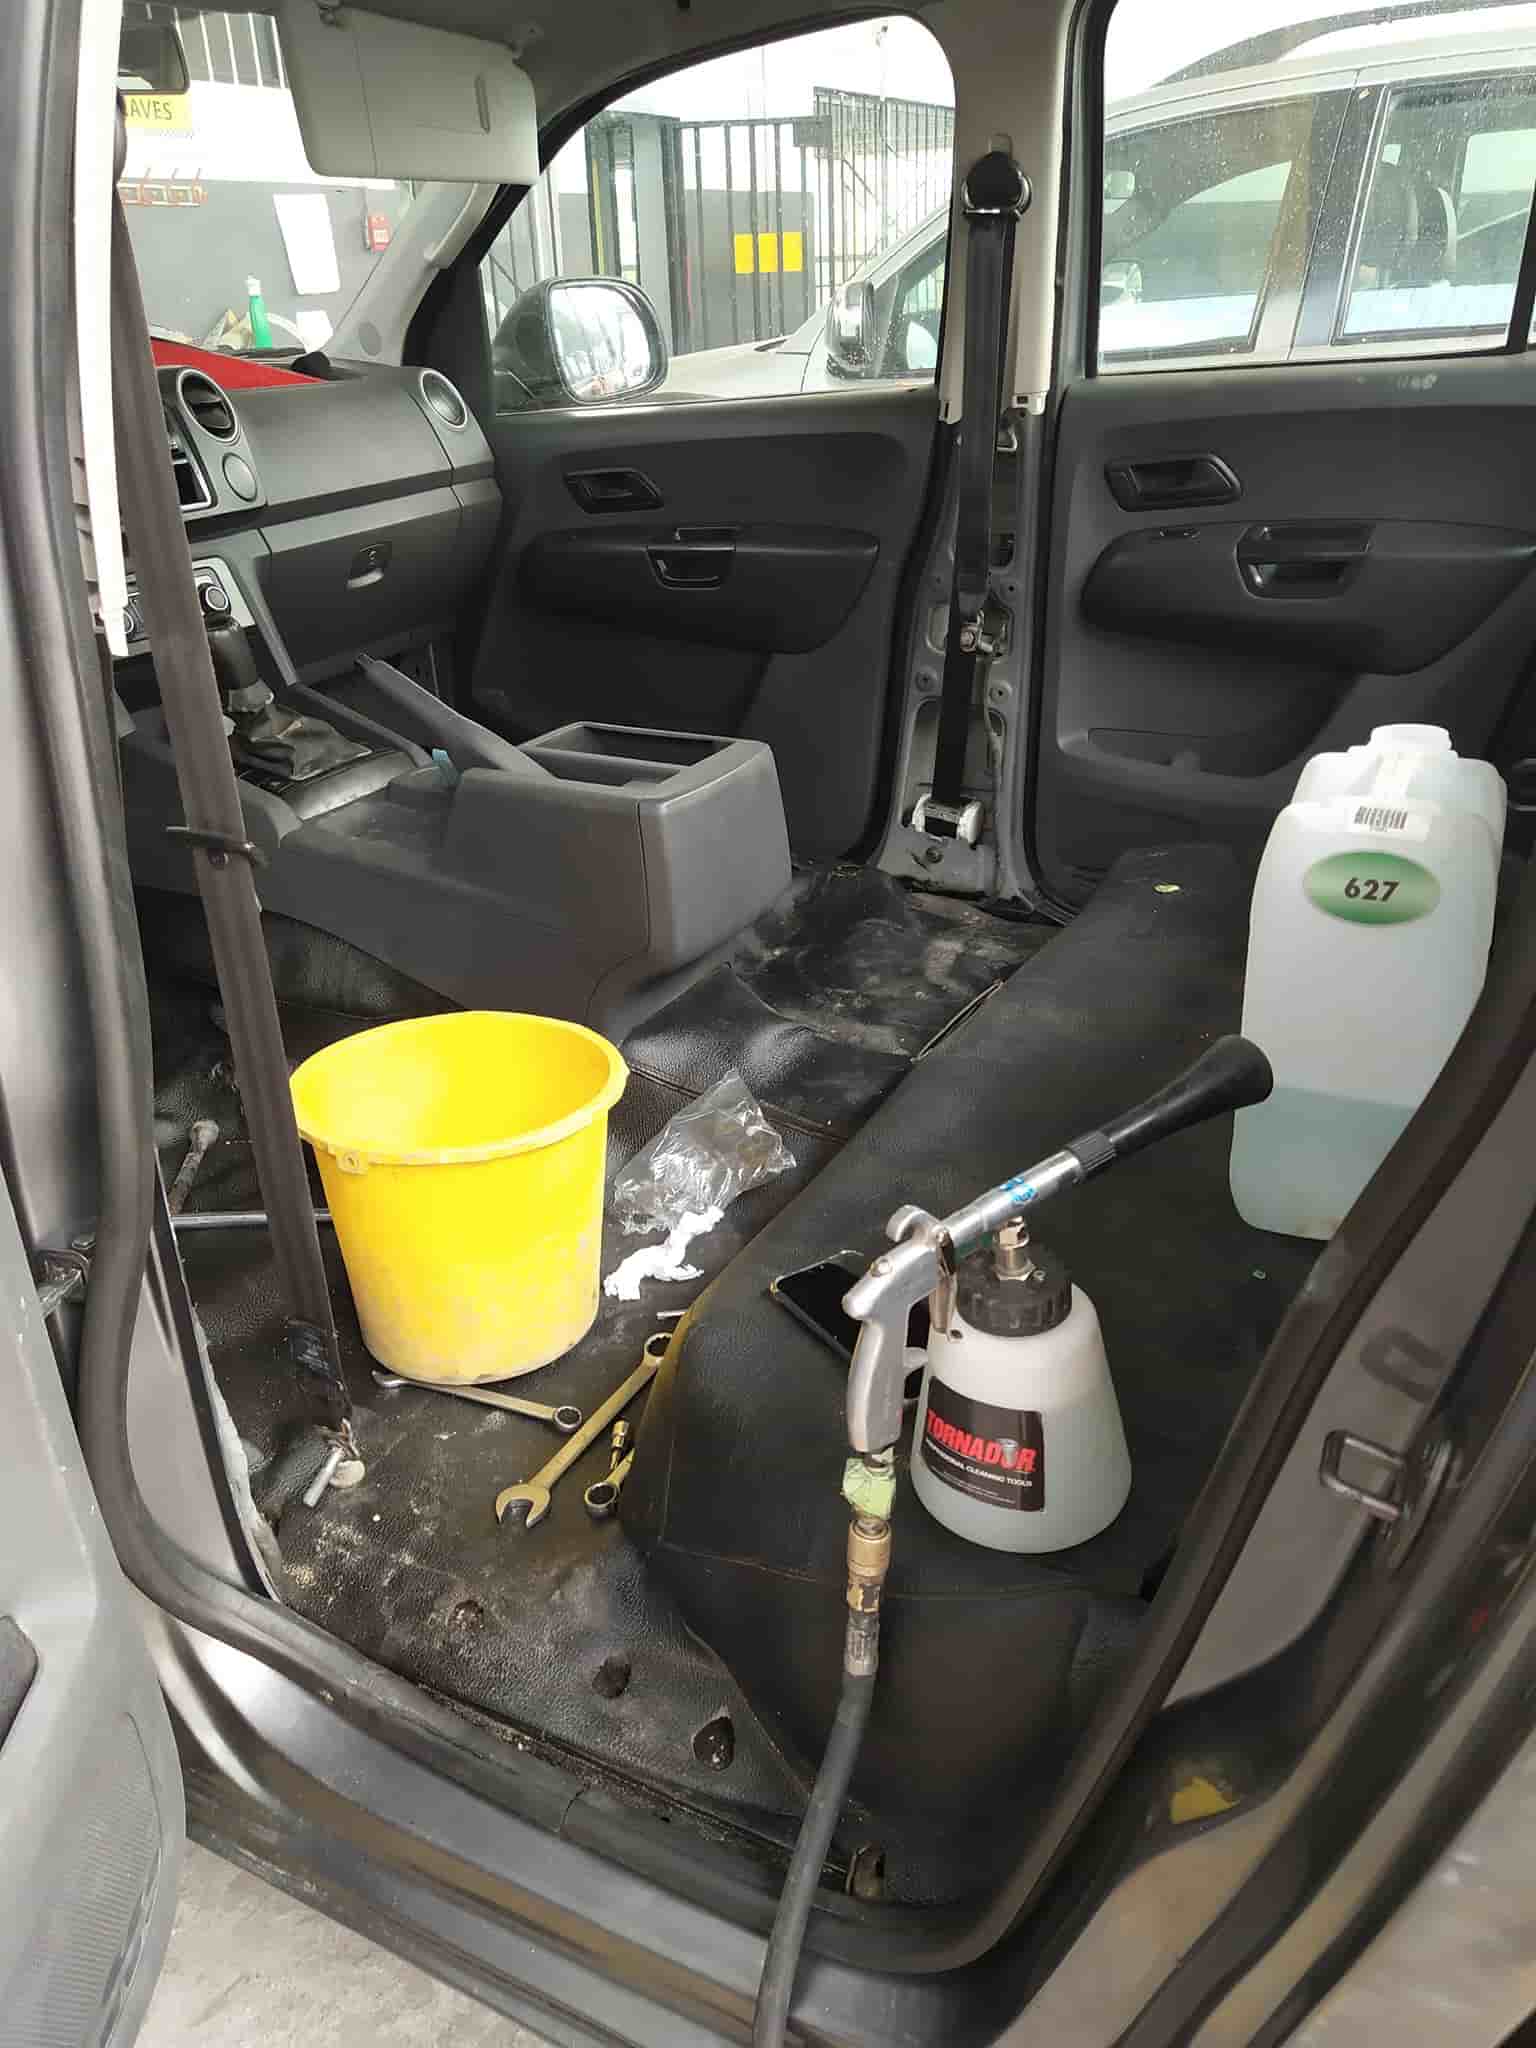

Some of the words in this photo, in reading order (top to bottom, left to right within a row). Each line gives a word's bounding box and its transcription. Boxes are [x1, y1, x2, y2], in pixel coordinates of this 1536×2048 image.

[125, 97, 173, 121] AVES
[1344, 877, 1400, 902] 627
[927, 1408, 1037, 1472] TORNADOR
